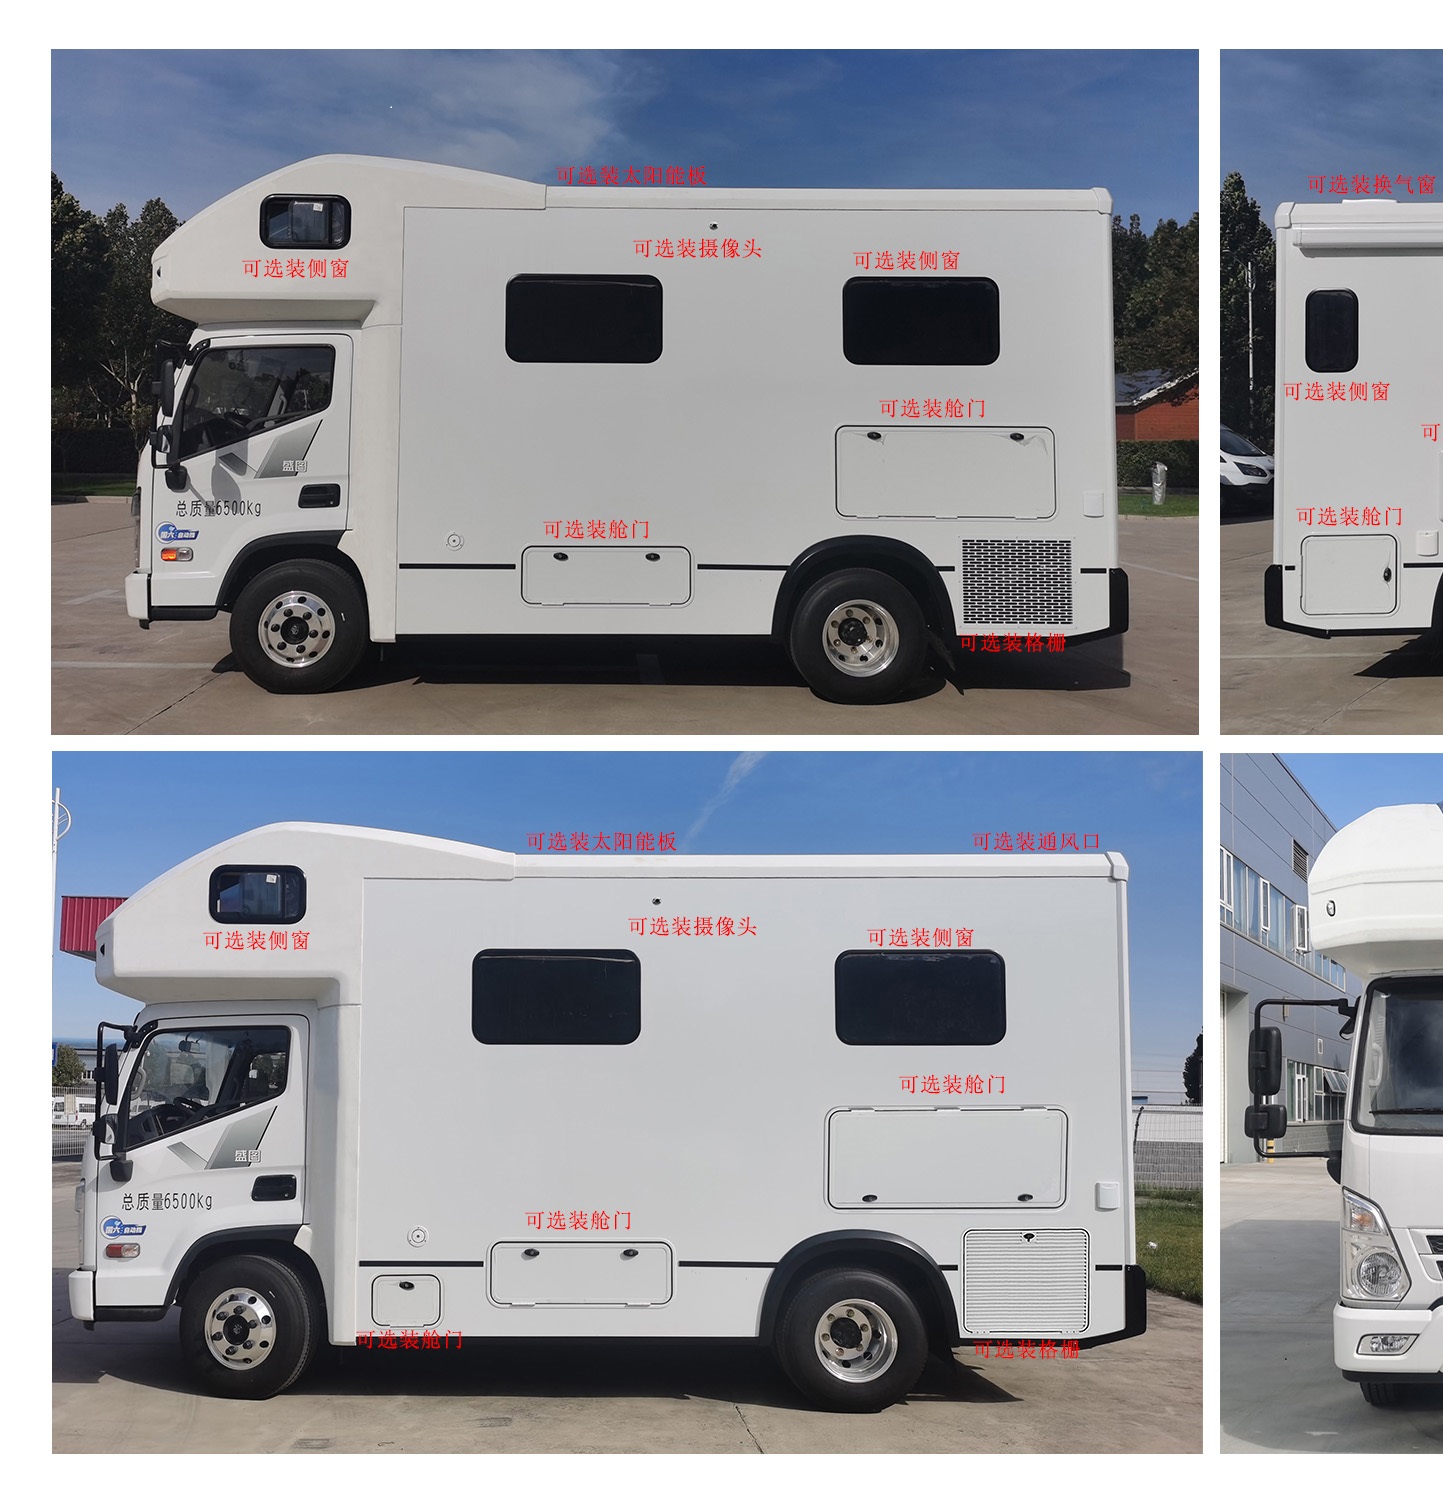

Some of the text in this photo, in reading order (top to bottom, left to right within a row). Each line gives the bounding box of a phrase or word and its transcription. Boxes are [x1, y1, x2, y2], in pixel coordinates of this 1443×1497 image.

[175, 500, 262, 517] 总质量6500kg
[121, 1192, 213, 1211] 总质量6500kg
